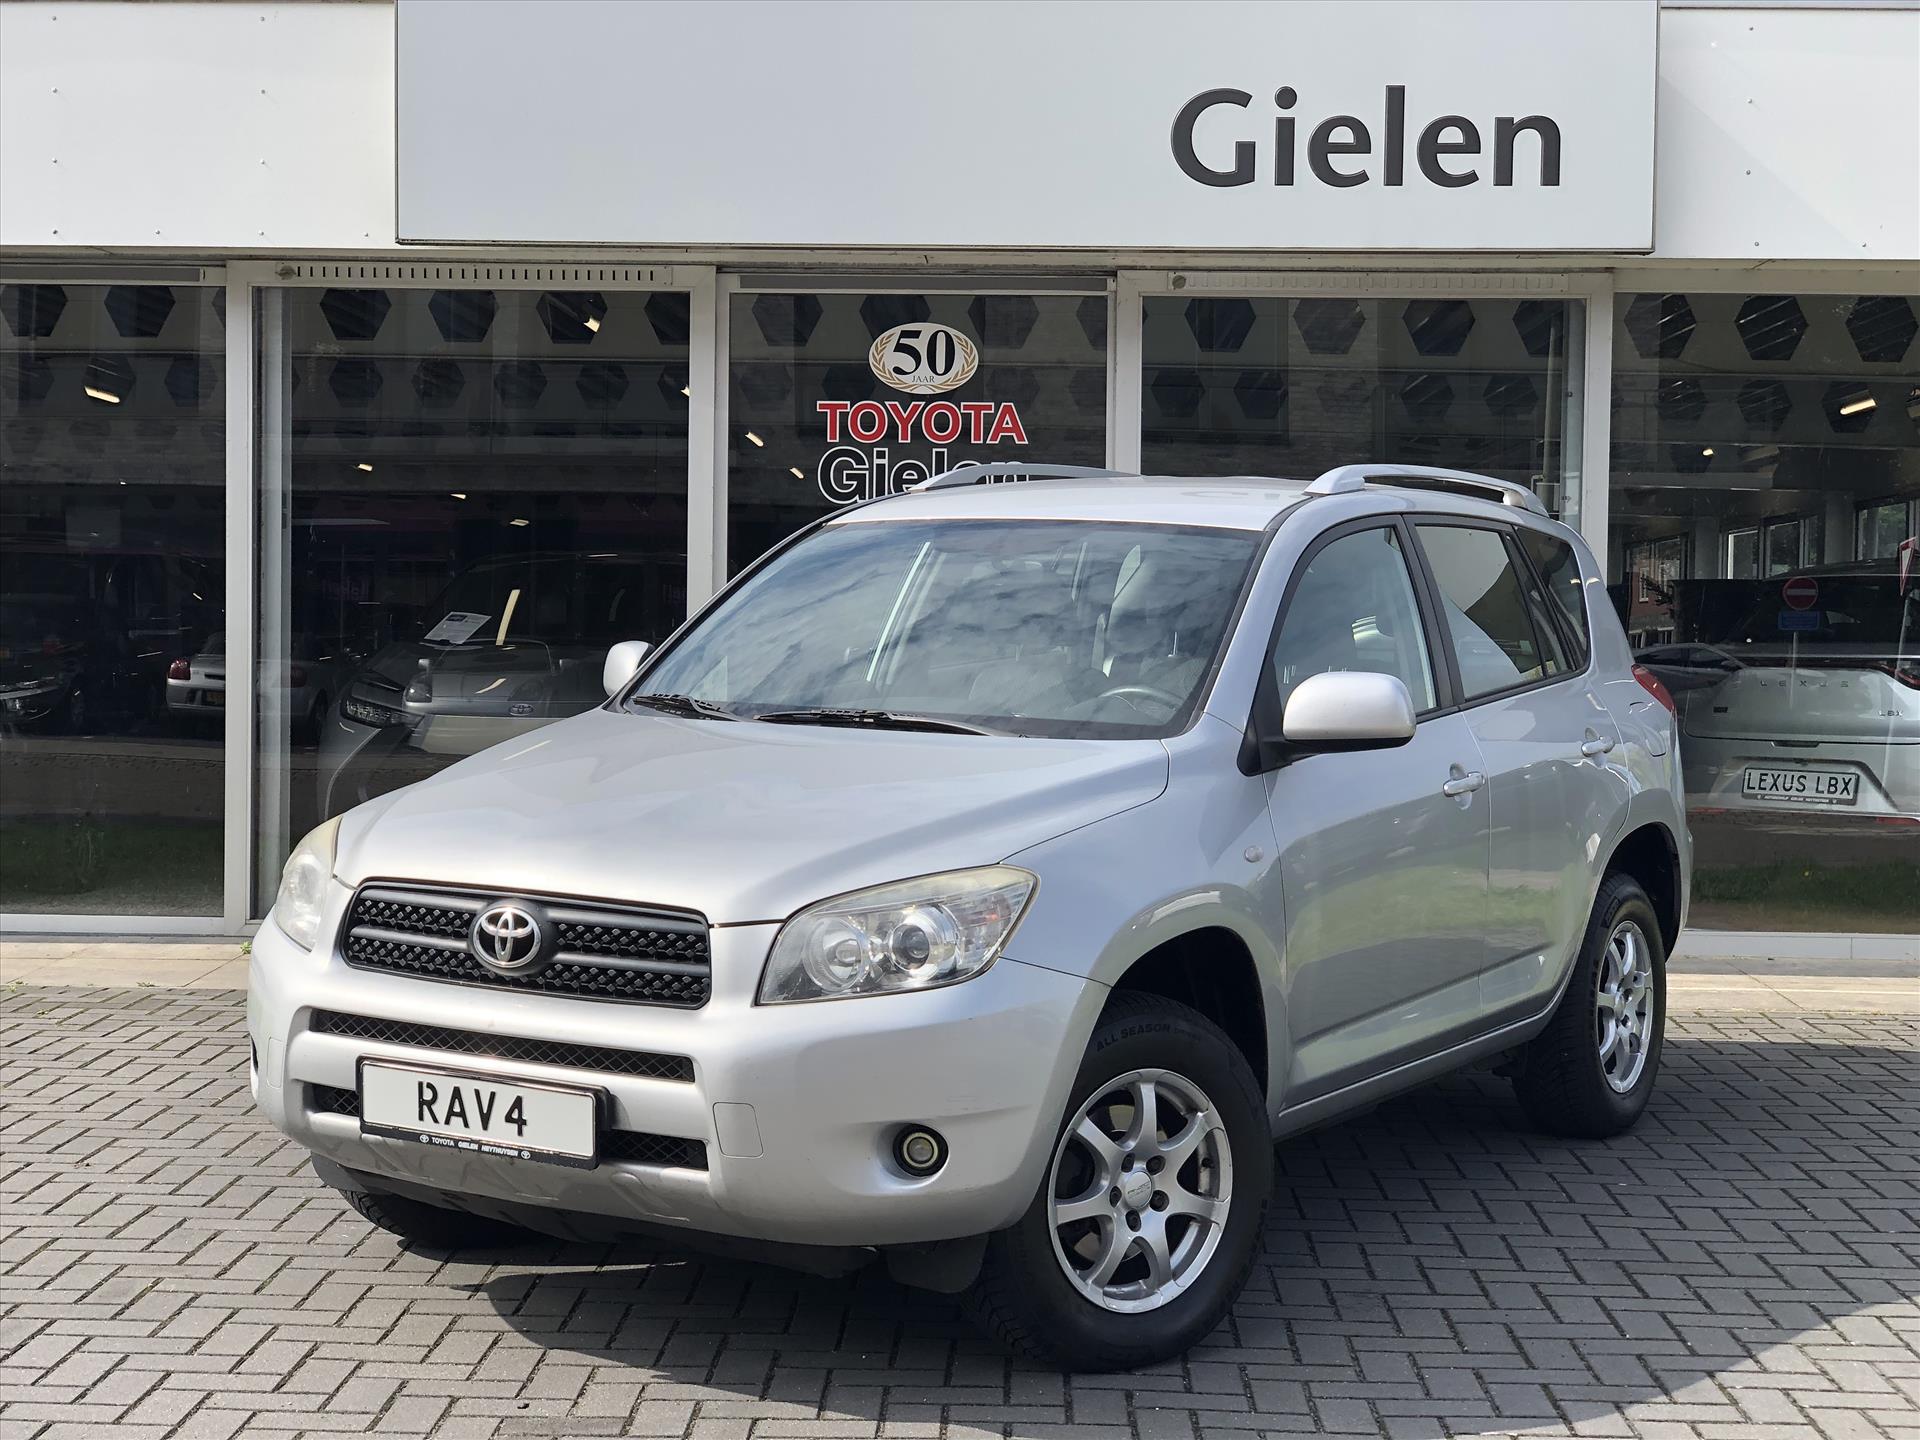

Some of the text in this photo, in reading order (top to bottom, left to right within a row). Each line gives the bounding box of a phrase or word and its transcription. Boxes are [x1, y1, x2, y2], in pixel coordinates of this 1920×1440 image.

[1170, 85, 1561, 188] Gielen
[891, 329, 957, 377] 50
[911, 375, 936, 384] JAAR
[816, 400, 1029, 445] TOYOTA
[817, 446, 1030, 505] Giel
[1746, 771, 1853, 797] LEXUS LBX
[1095, 1032, 1120, 1053] ALL
[1119, 1023, 1171, 1040] SEASON
[431, 1136, 455, 1147] TOYOTA
